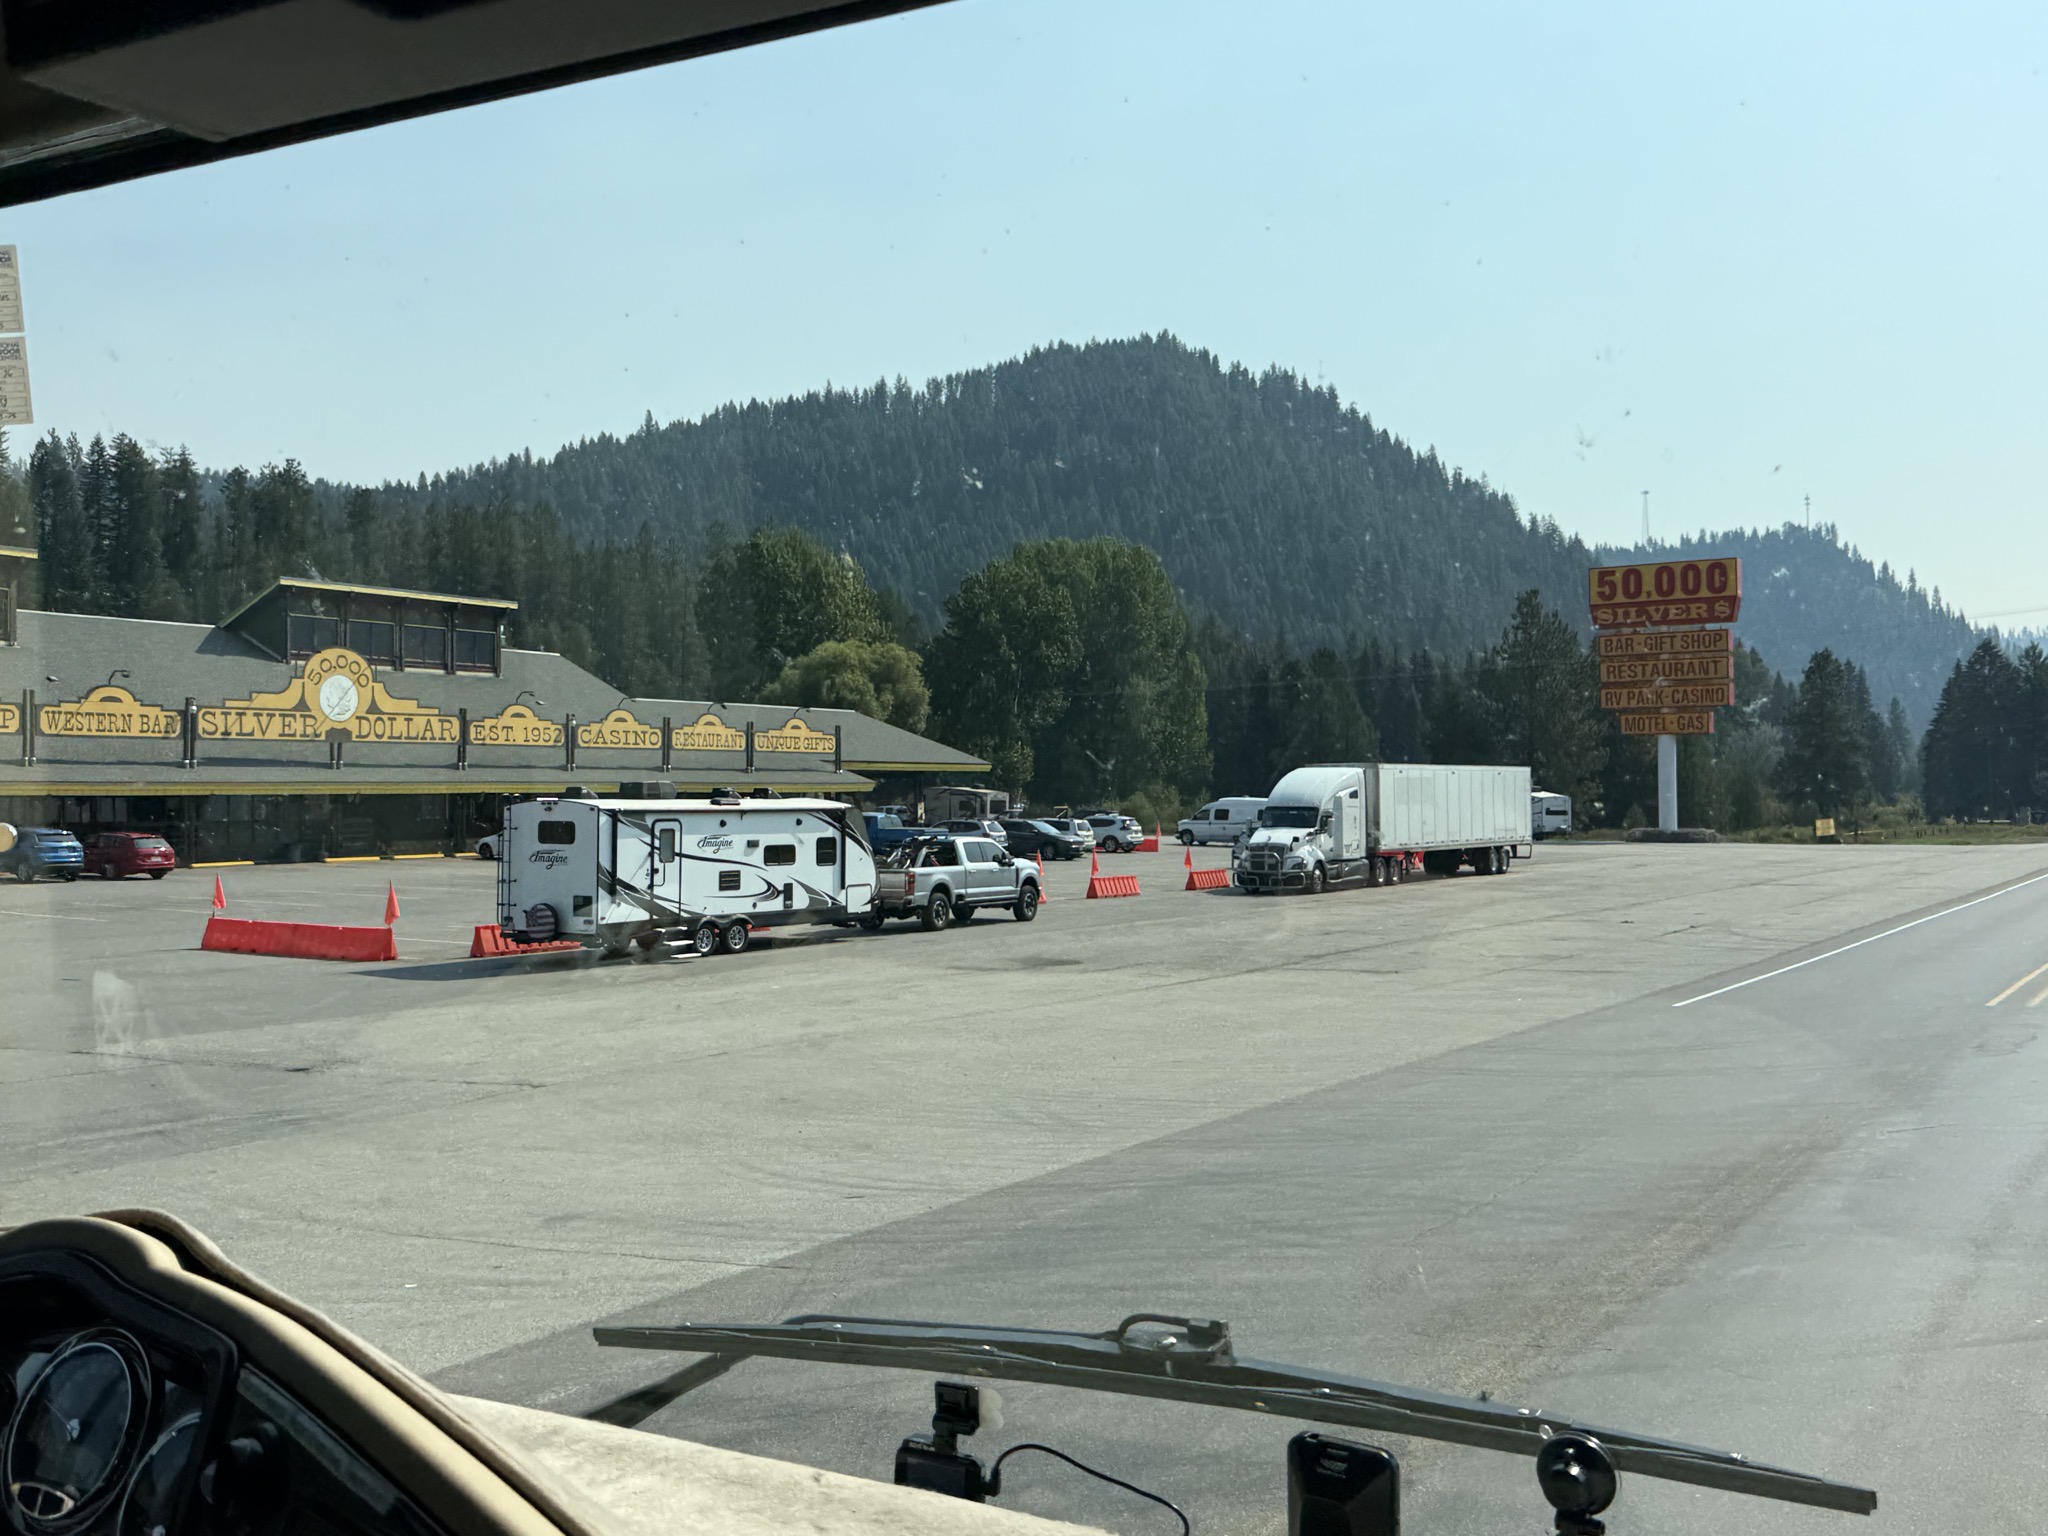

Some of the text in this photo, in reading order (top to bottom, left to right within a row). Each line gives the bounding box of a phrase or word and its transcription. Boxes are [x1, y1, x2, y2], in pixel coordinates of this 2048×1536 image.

[1597, 561, 1728, 601] 50,000
[1597, 600, 1731, 625] SILVER $
[1604, 637, 1635, 653] BAR
[1644, 635, 1677, 651] GIFT
[1680, 632, 1723, 650] SHOP
[307, 654, 370, 688] 50,000
[1606, 660, 1722, 680] RESTAURANT
[1605, 690, 1625, 706] RV
[1671, 687, 1725, 704] CASINO
[45, 710, 179, 734] WESTERN BAR
[201, 710, 457, 741] SILVER DOLLAR
[1624, 715, 1704, 733] MOTEL GAS
[473, 724, 563, 744] EST. 1952
[580, 729, 660, 746] CASINO
[674, 731, 745, 749] RESTAURANT
[756, 735, 834, 751] UNIQUE GIFTS
[697, 835, 733, 854] Imagine
[529, 850, 569, 870] Imagine
